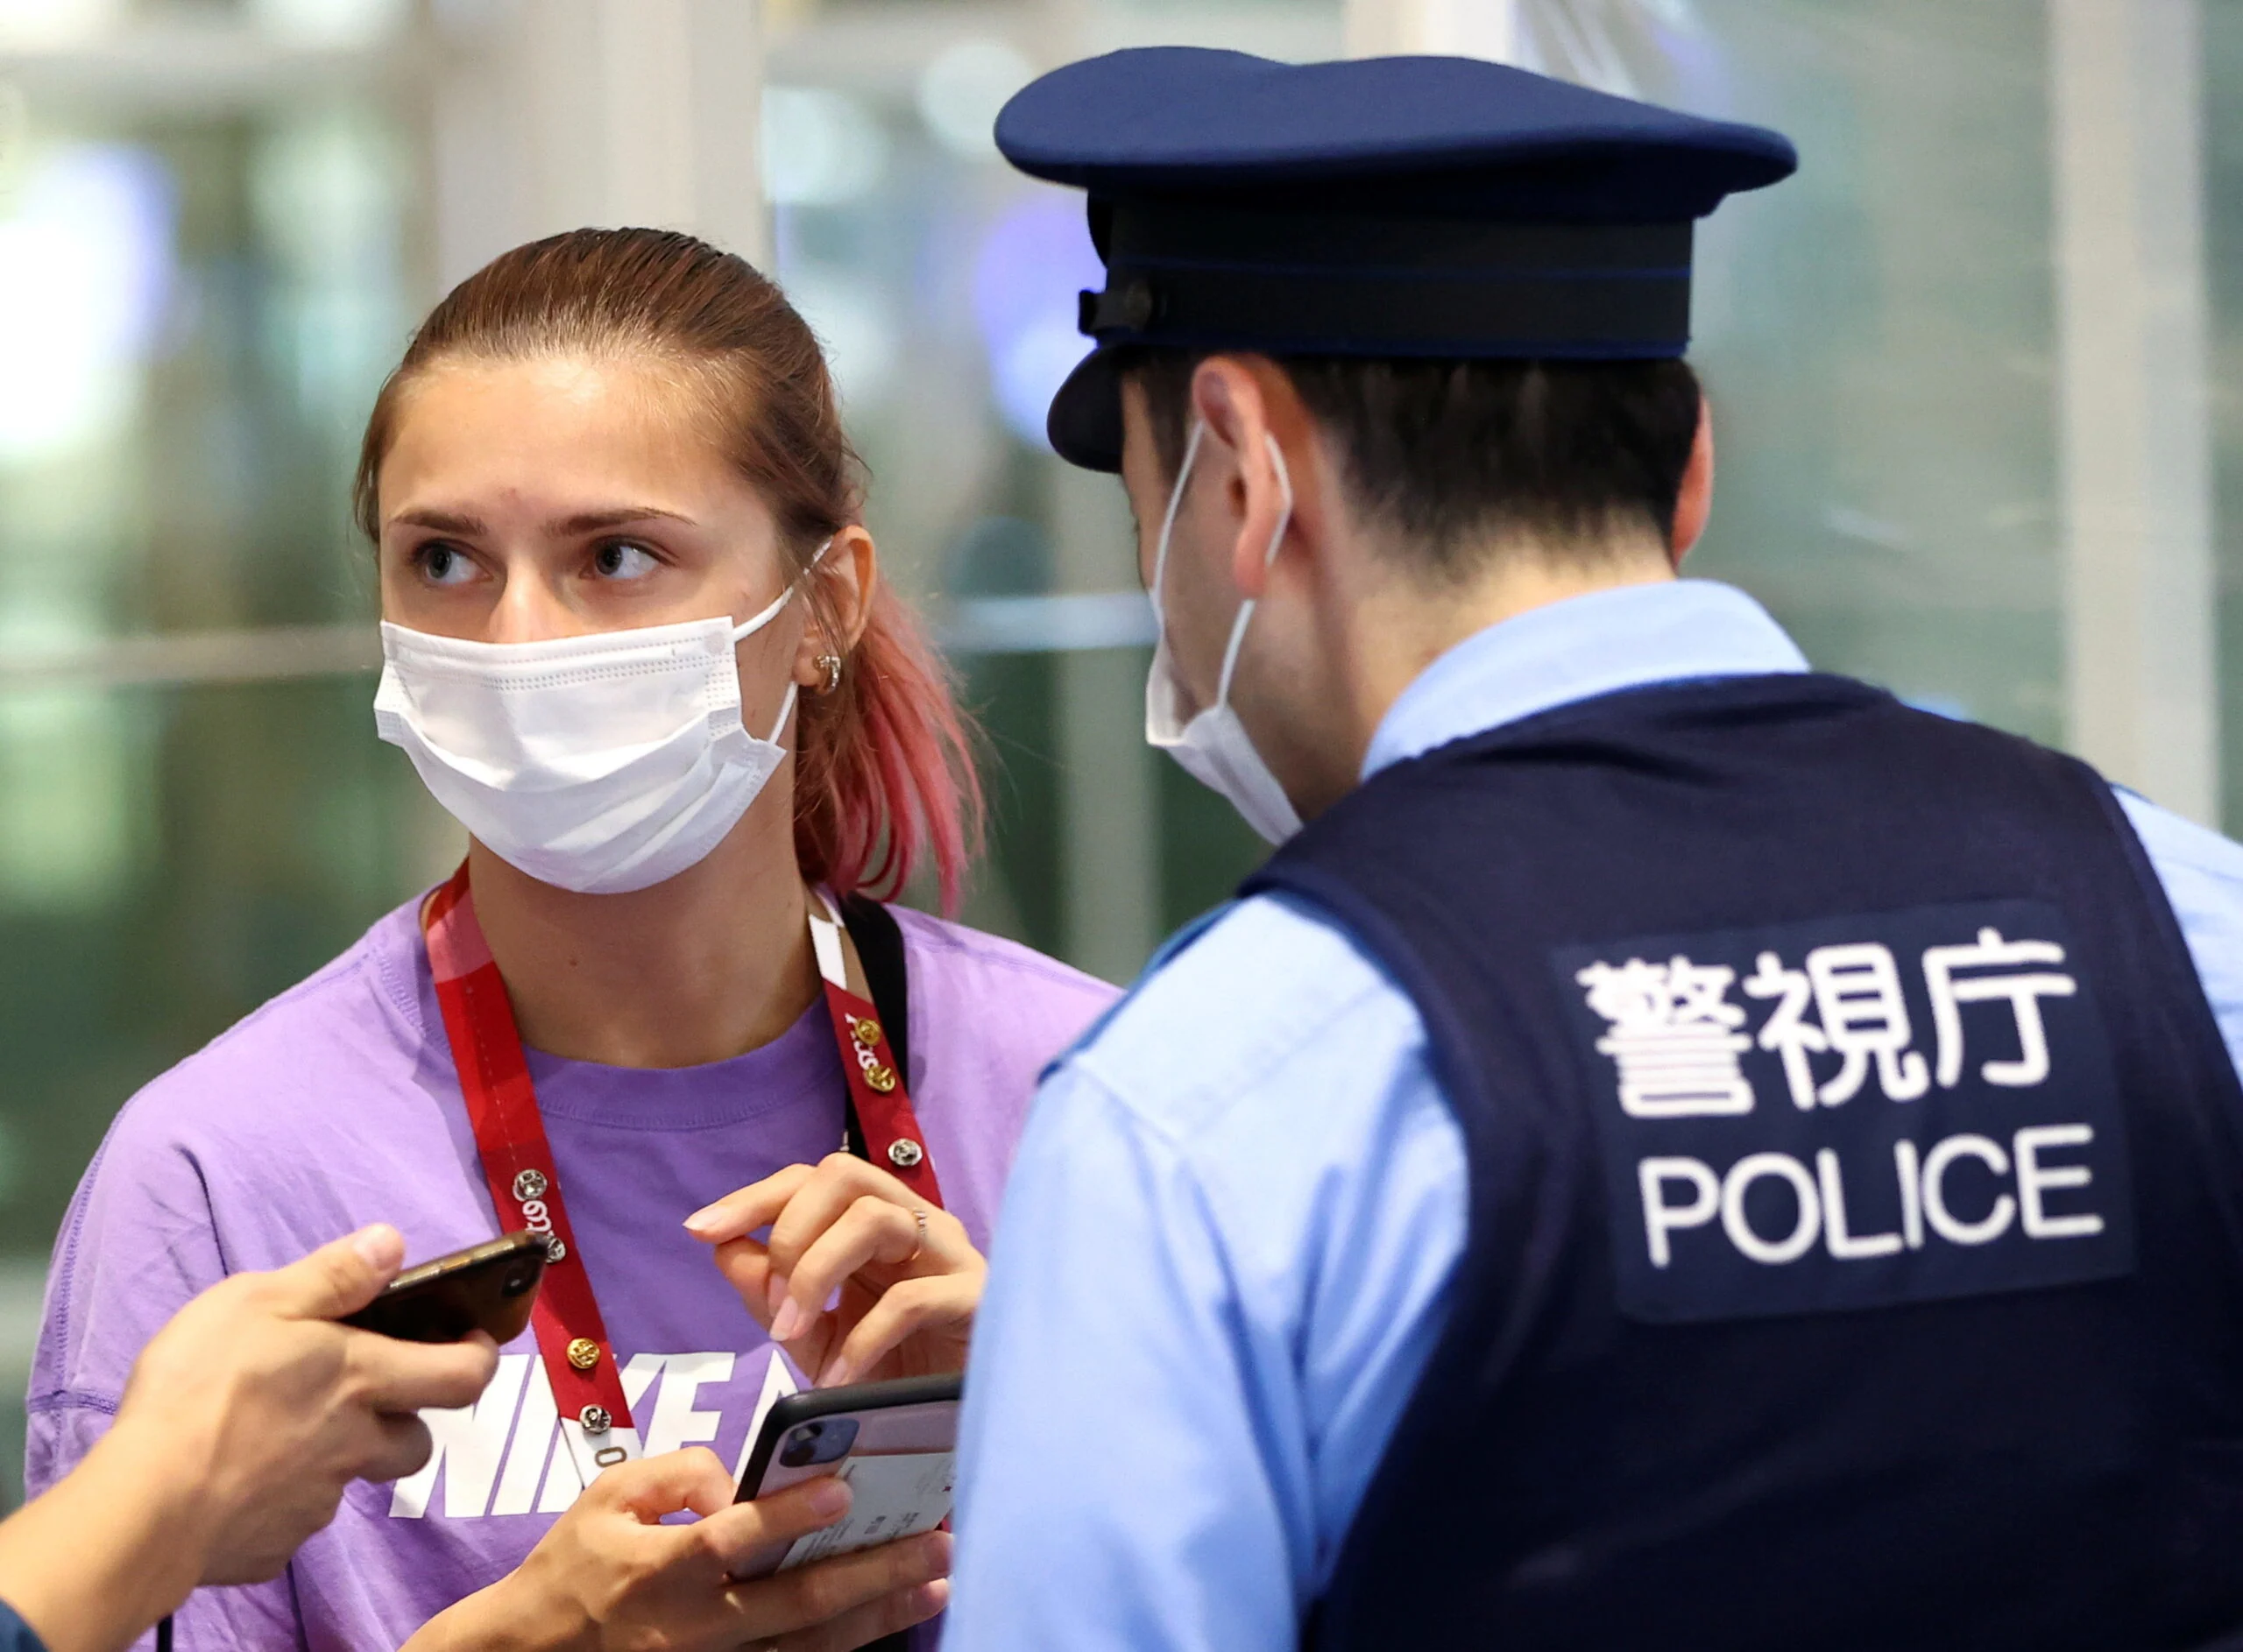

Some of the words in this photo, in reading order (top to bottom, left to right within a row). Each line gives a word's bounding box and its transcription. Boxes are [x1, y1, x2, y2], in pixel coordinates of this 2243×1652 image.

[1576, 927, 2077, 1118] 警視庁
[1638, 1125, 2103, 1267] POLICE
